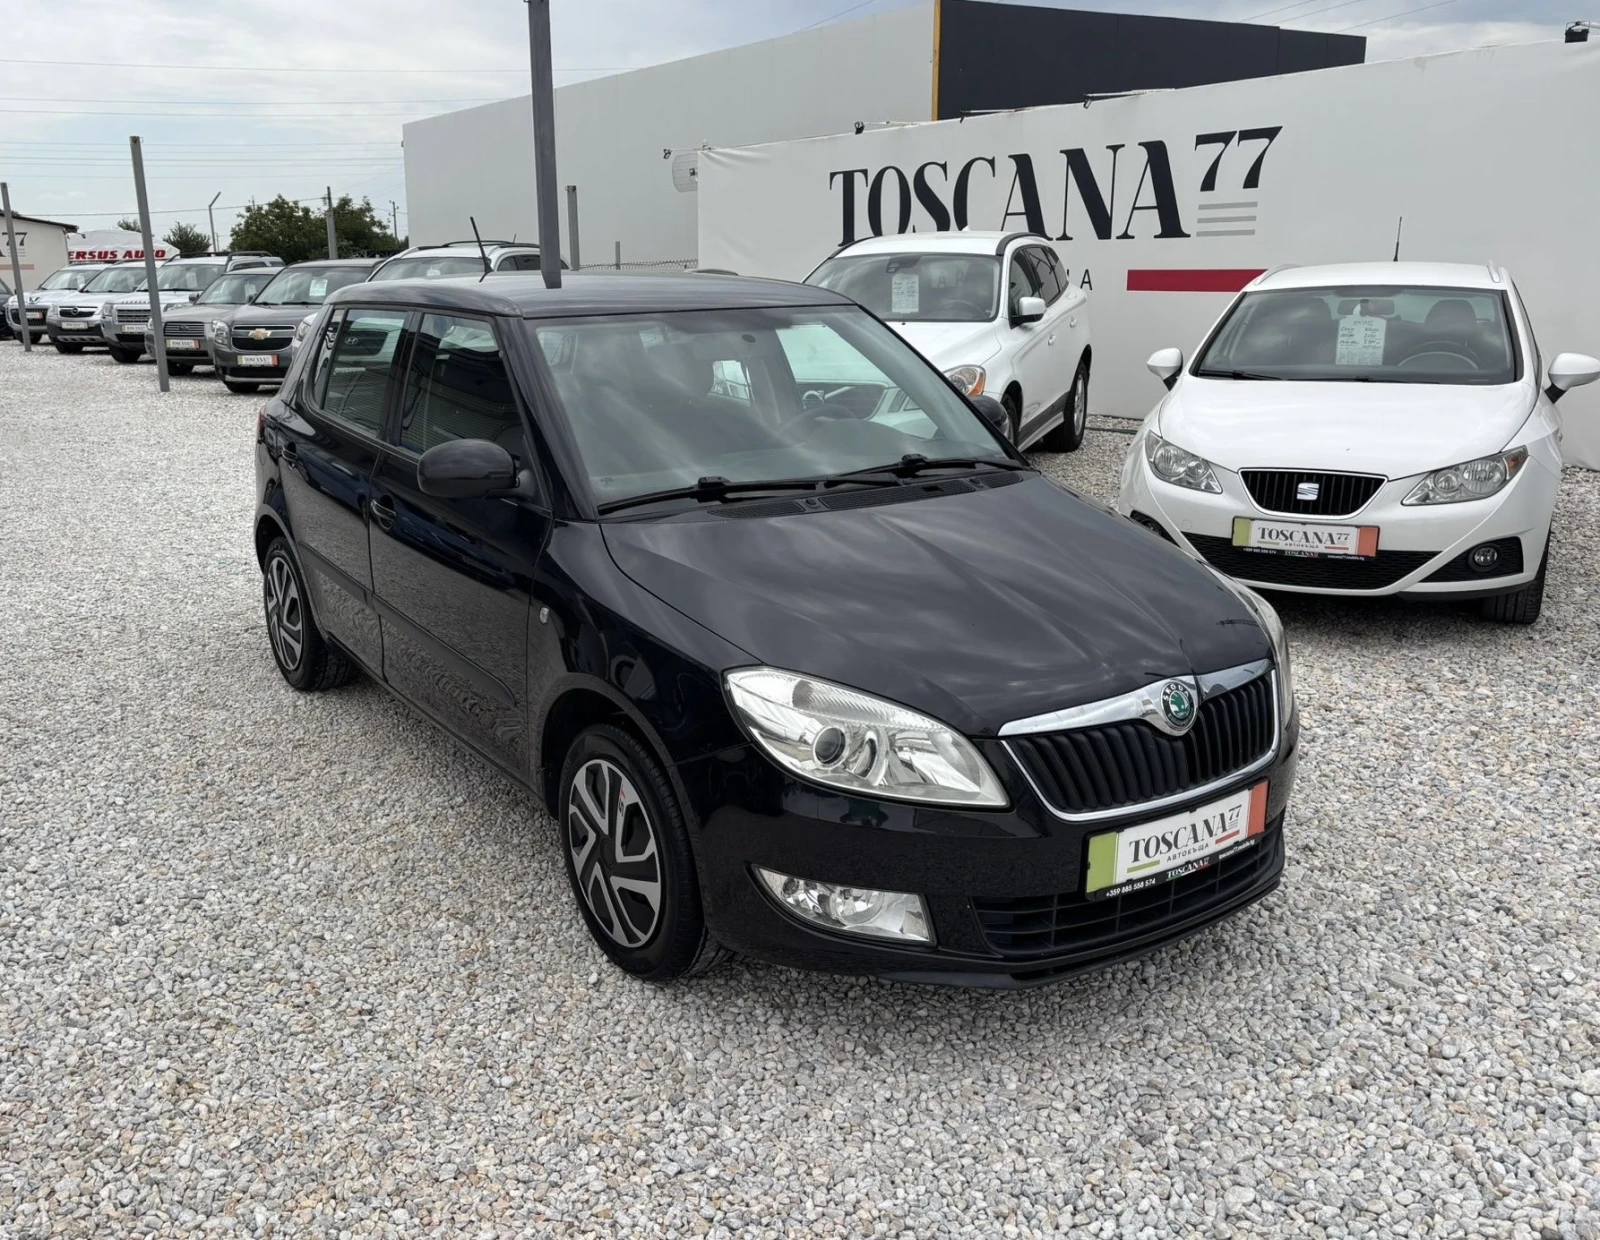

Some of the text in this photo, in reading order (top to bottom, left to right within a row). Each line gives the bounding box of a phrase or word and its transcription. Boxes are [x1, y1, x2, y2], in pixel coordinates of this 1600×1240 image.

[829, 139, 1191, 247] TOSCANA
[68, 249, 166, 260] ERSUS AUO
[1258, 526, 1337, 545] TOSCANA
[1128, 812, 1229, 863] TOSCANA
